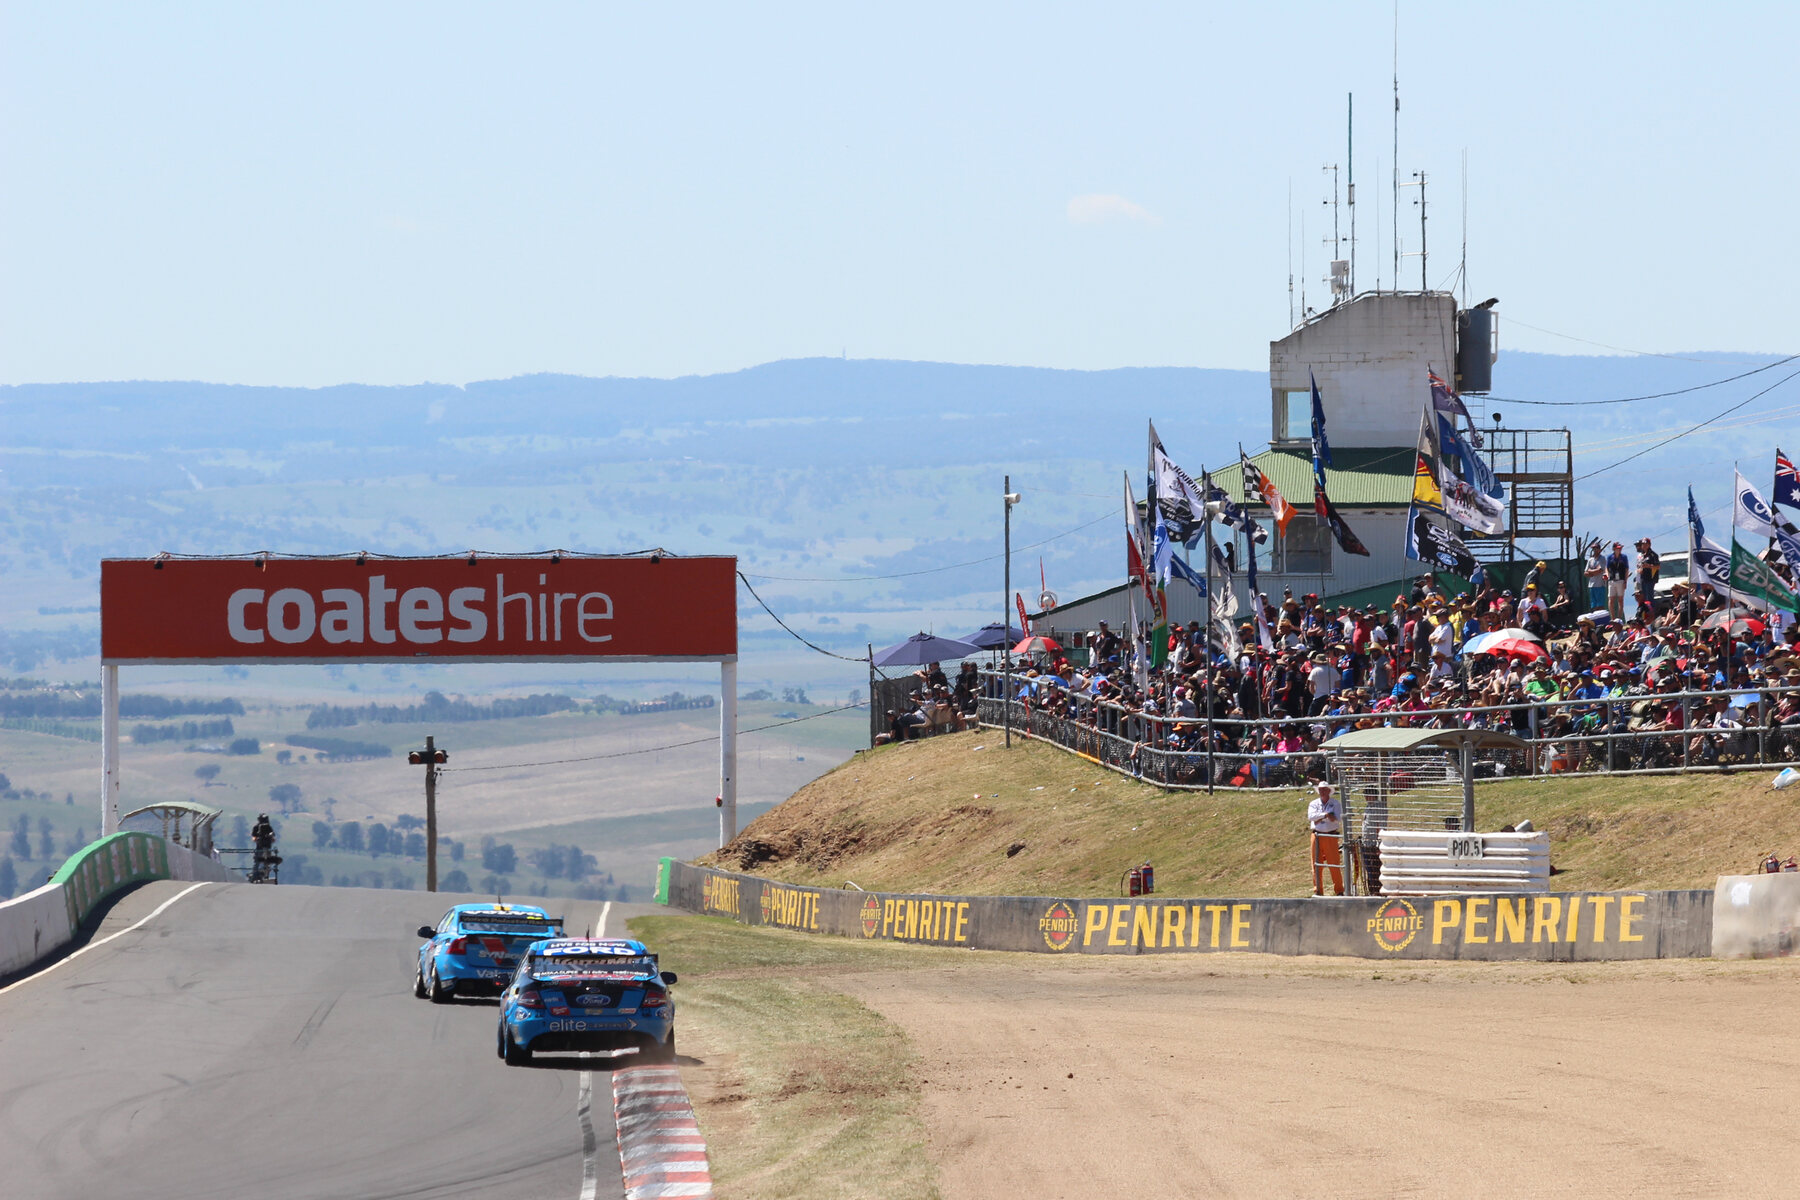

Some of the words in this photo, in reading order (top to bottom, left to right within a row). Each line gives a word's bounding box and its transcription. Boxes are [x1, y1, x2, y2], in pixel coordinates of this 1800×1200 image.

[1452, 840, 1480, 856] P10.5
[860, 908, 881, 920] PENRITE
[882, 899, 969, 942] PENRITE
[1432, 896, 1646, 944] PENRITE
[1039, 918, 1079, 933] PENRITE
[1083, 904, 1251, 948] PENRITE
[1366, 915, 1424, 933] PENRITE
[542, 946, 636, 956] FORD
[549, 1019, 587, 1032] elite
